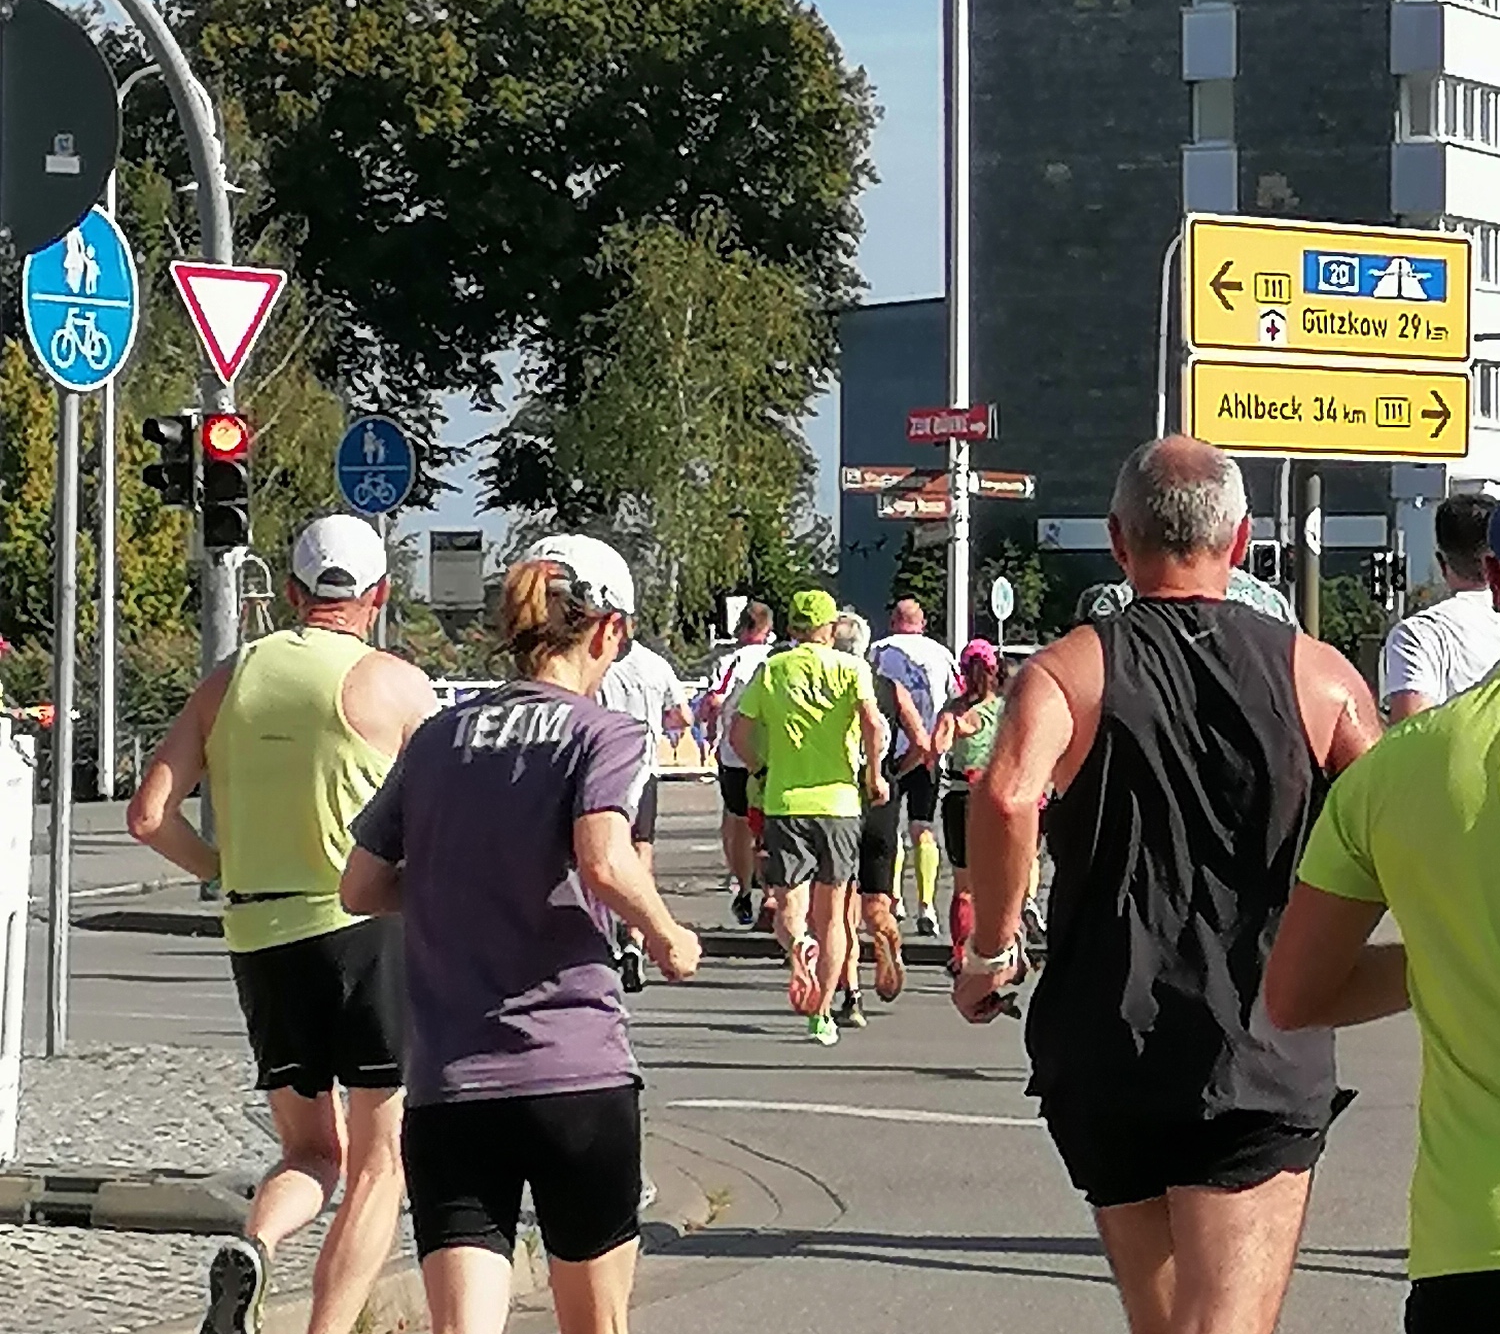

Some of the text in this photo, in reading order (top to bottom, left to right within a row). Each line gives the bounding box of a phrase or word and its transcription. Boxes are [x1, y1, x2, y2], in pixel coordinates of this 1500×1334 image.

[1263, 279, 1283, 299] 111
[1302, 307, 1449, 341] Gützkow 29 km
[1217, 393, 1403, 425] Ahlbeck 34 km 111
[453, 703, 575, 748] TEAM
